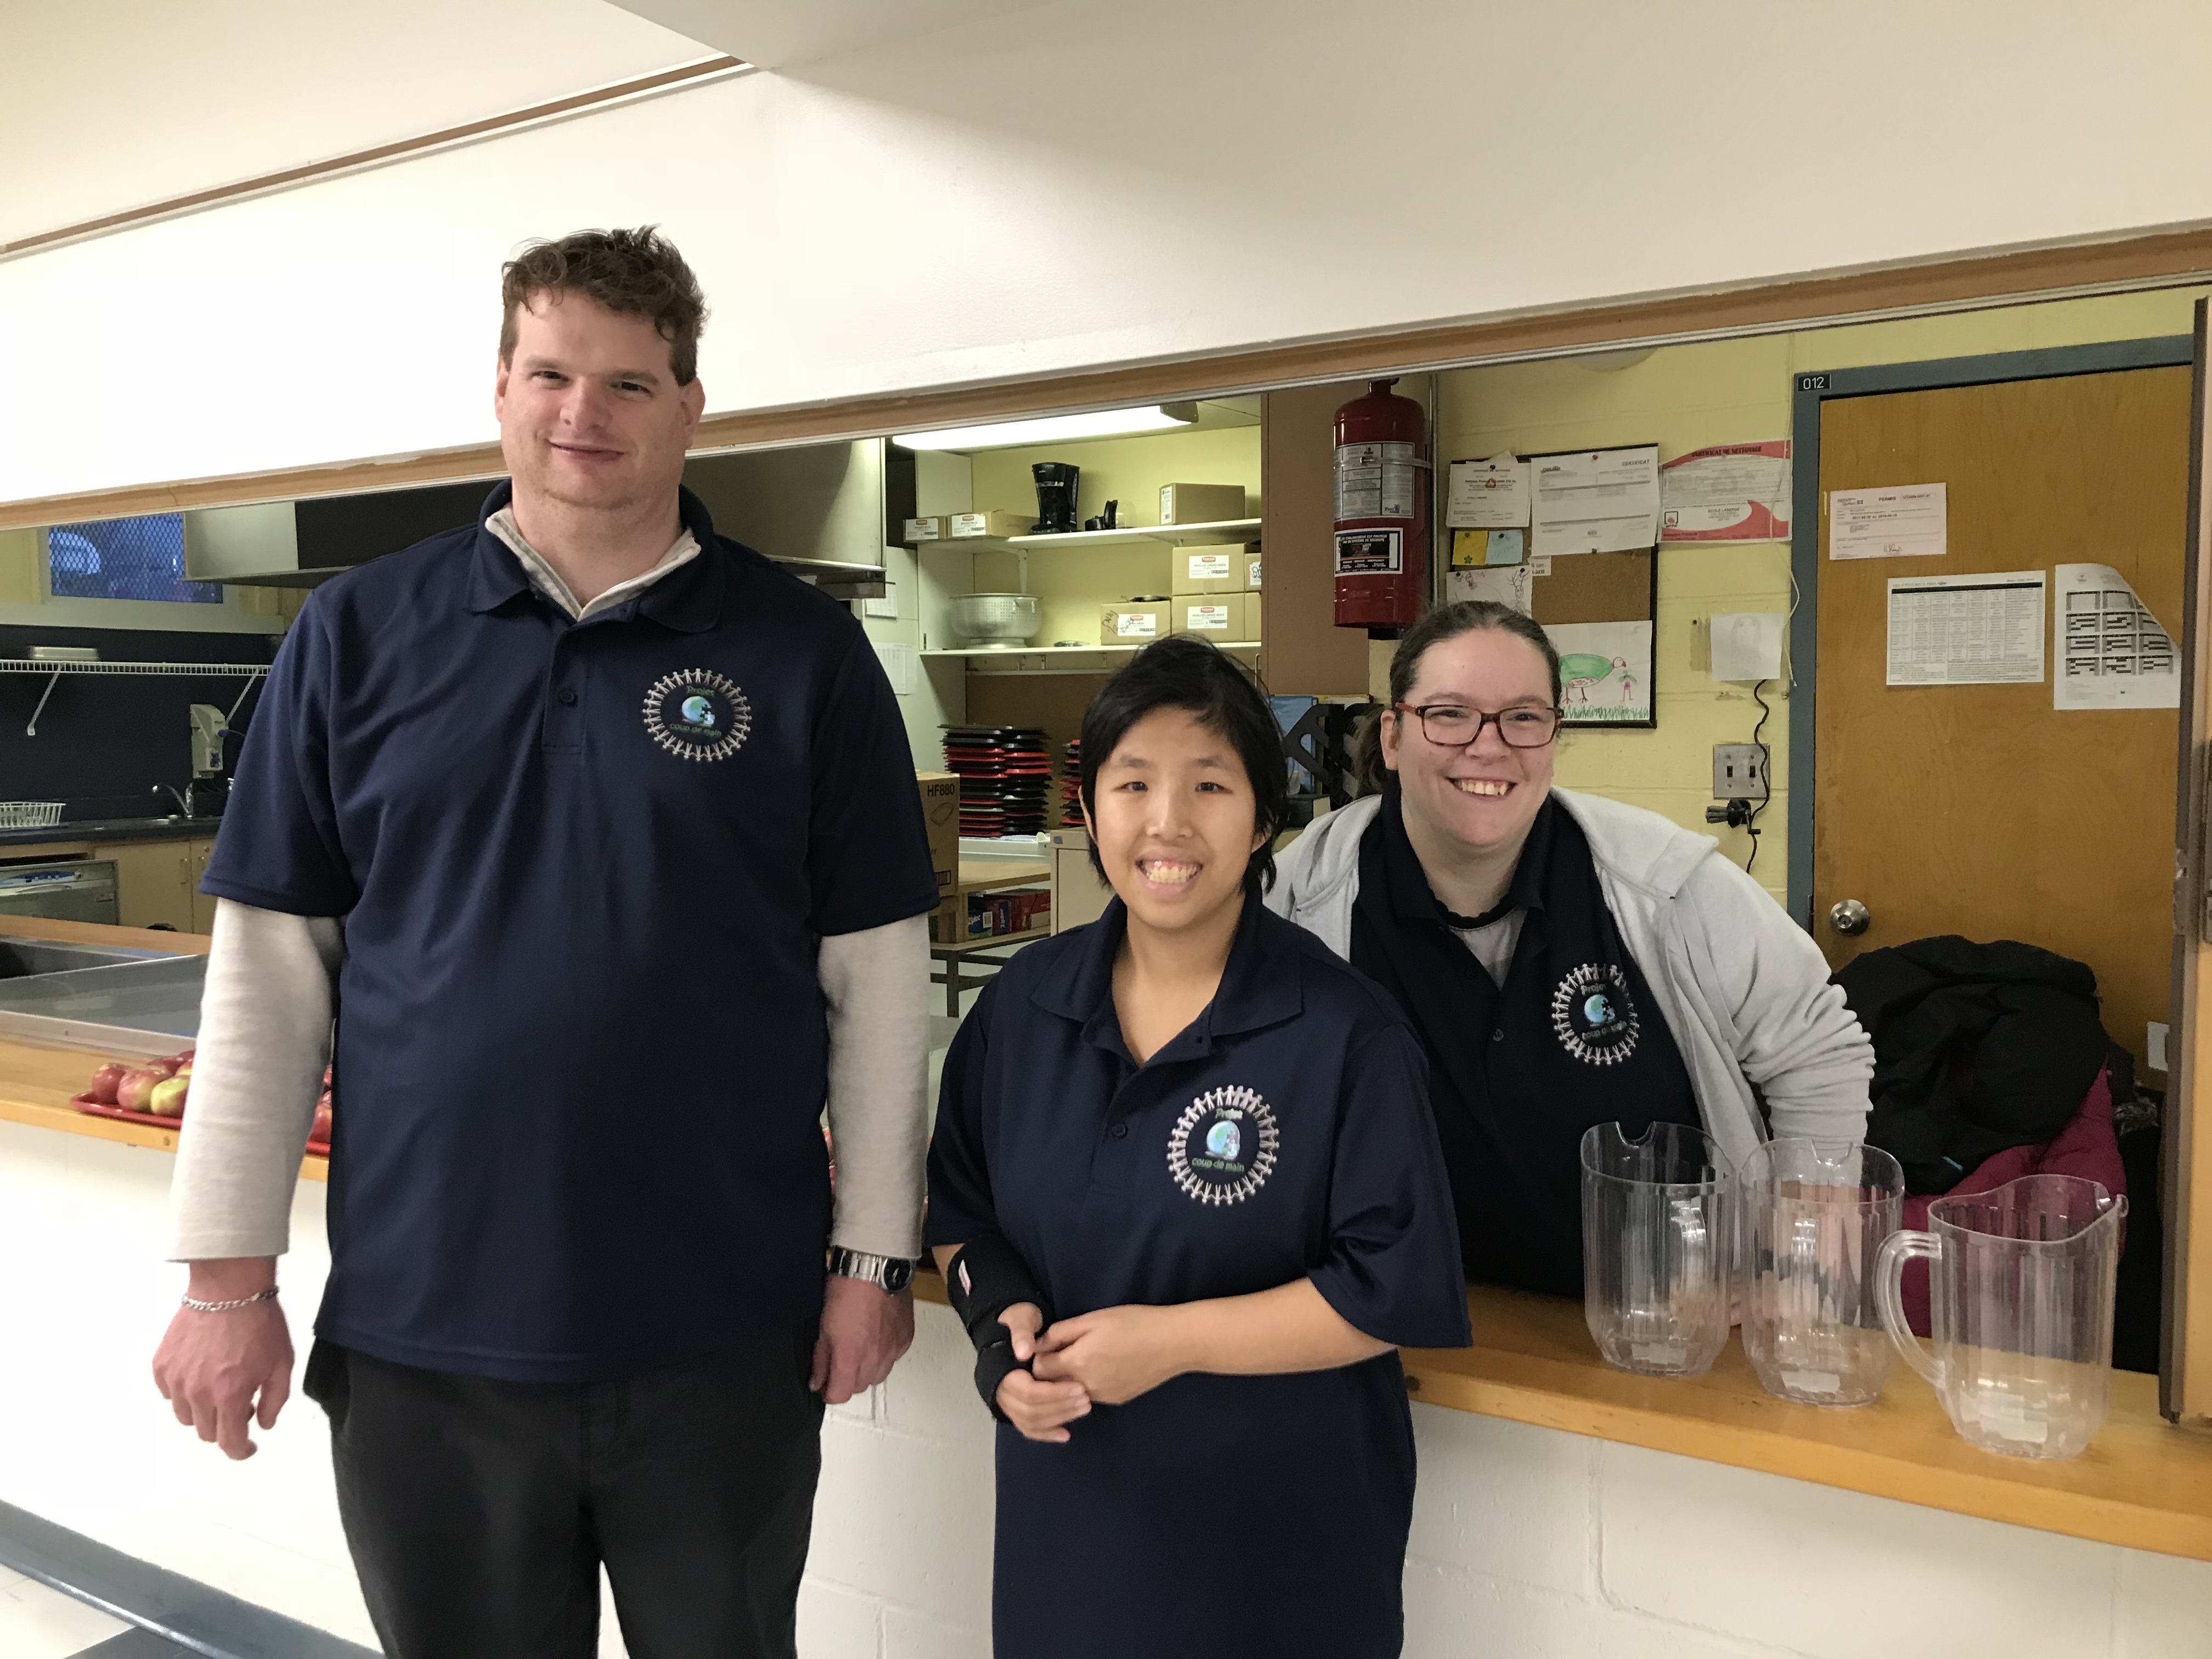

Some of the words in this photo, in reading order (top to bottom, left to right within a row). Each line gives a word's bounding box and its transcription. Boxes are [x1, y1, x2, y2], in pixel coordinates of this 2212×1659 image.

[1803, 376, 1824, 390] 012
[1692, 448, 1722, 457] CERTIFICAT
[703, 728, 722, 737] main
[927, 783, 955, 797] HF880
[1213, 1159, 1224, 1169] de
[1226, 1161, 1245, 1172] main
